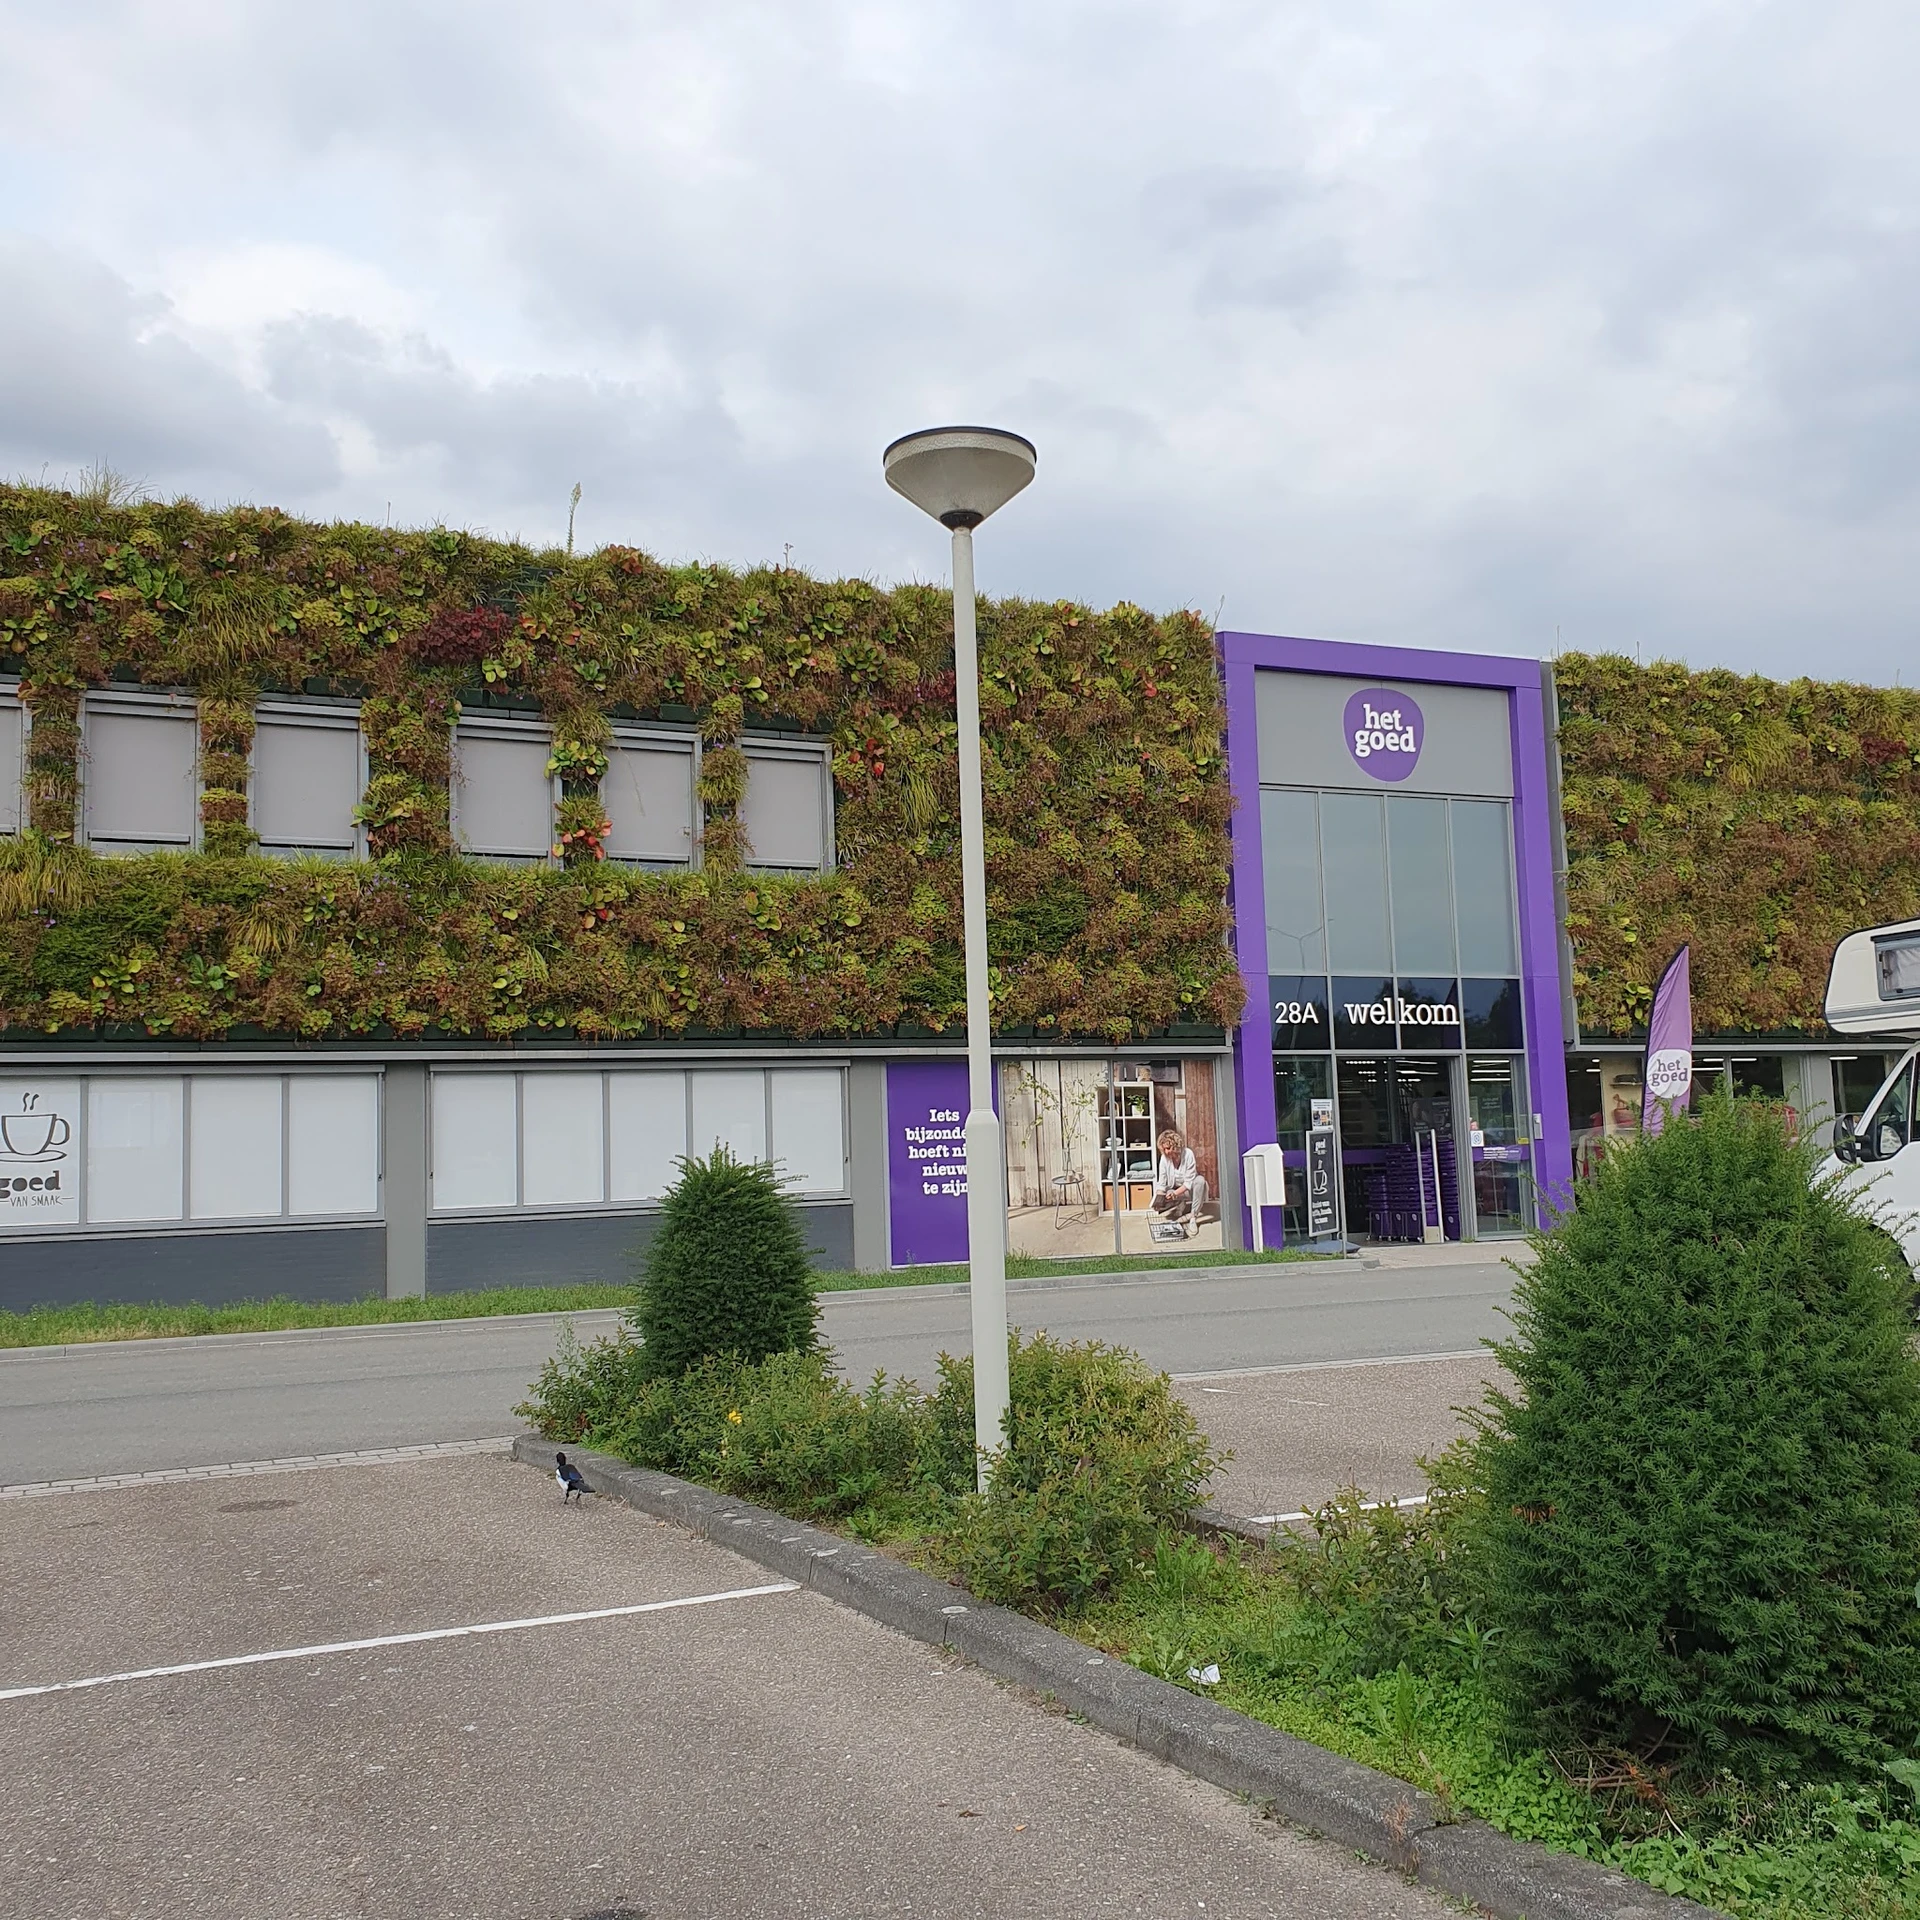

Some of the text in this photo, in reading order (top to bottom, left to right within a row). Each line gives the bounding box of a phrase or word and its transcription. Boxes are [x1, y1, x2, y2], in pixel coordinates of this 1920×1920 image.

[1363, 703, 1403, 731] het
[1354, 726, 1416, 758] goed
[1275, 998, 1460, 1025] 28A welkom
[1657, 1059, 1681, 1072] het
[1651, 1068, 1689, 1087] goed
[929, 1109, 960, 1122] Iets
[908, 1145, 950, 1159] hoeft
[922, 1162, 968, 1176] nieuw
[0, 1170, 61, 1199] goed
[923, 1182, 938, 1194] te
[10, 1194, 63, 1207] VAN SMAAK
